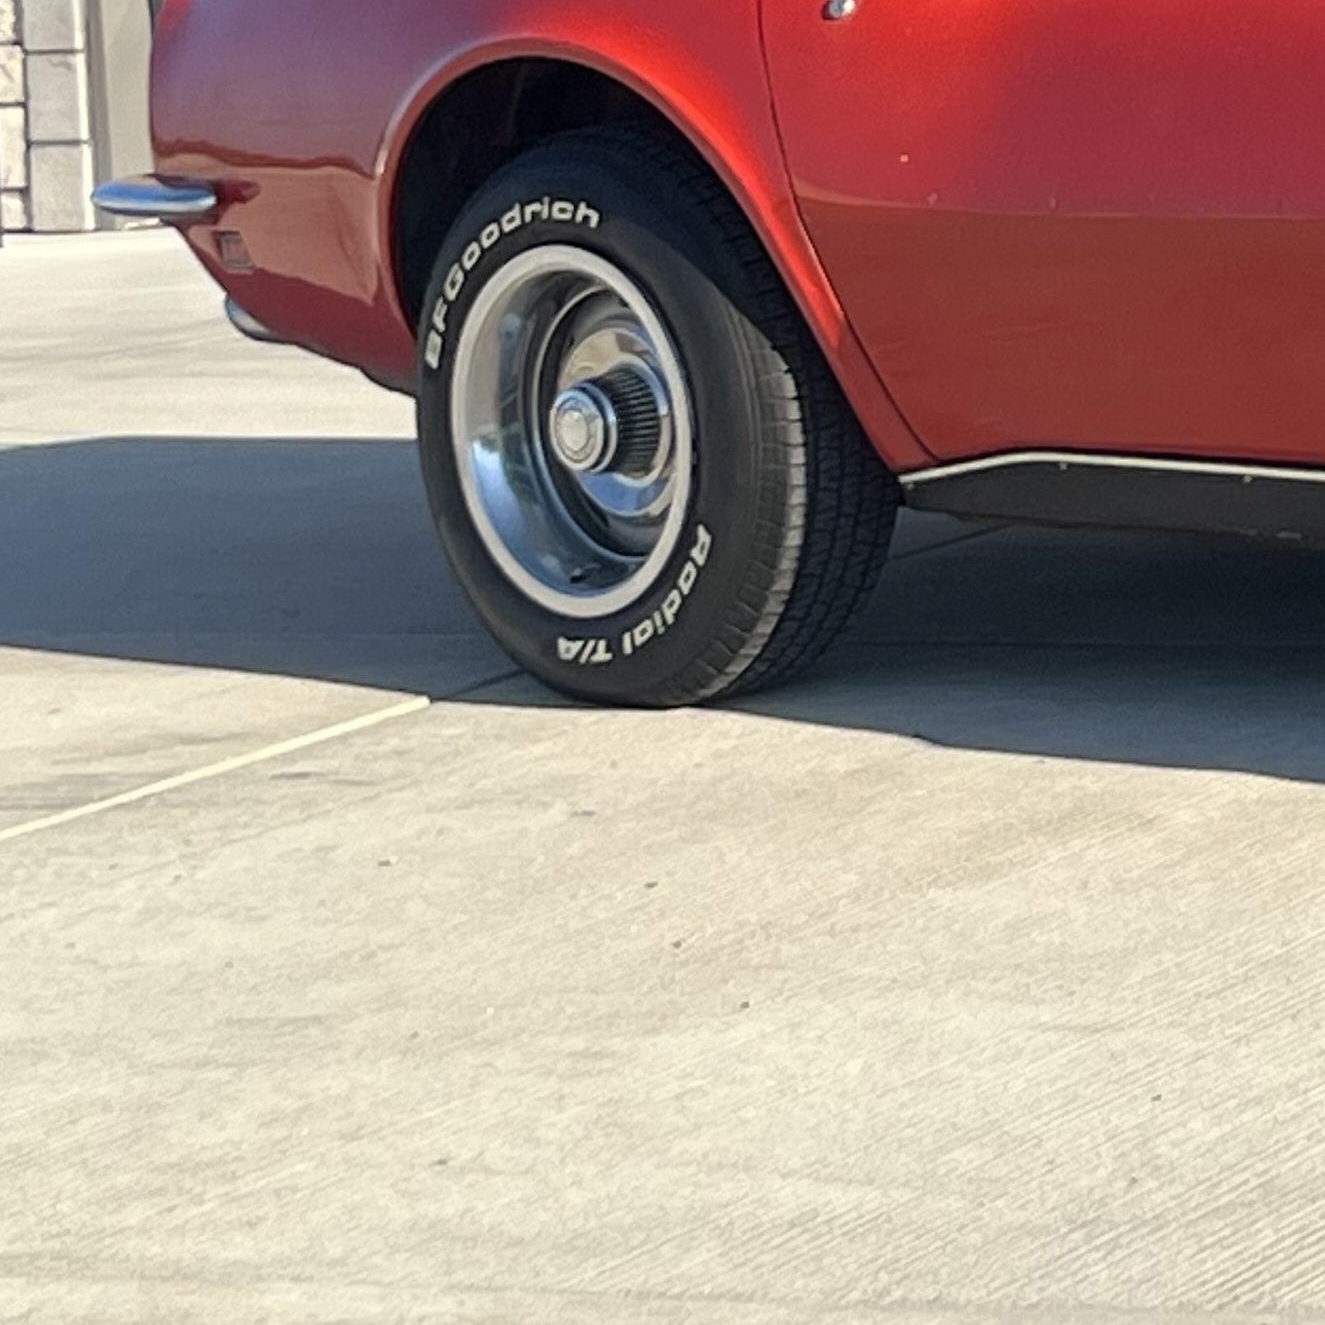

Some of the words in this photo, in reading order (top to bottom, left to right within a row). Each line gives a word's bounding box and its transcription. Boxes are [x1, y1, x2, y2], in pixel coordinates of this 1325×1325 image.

[424, 196, 600, 370] BFGoodrich
[556, 636, 613, 664] T/A
[622, 524, 712, 655] Radial
